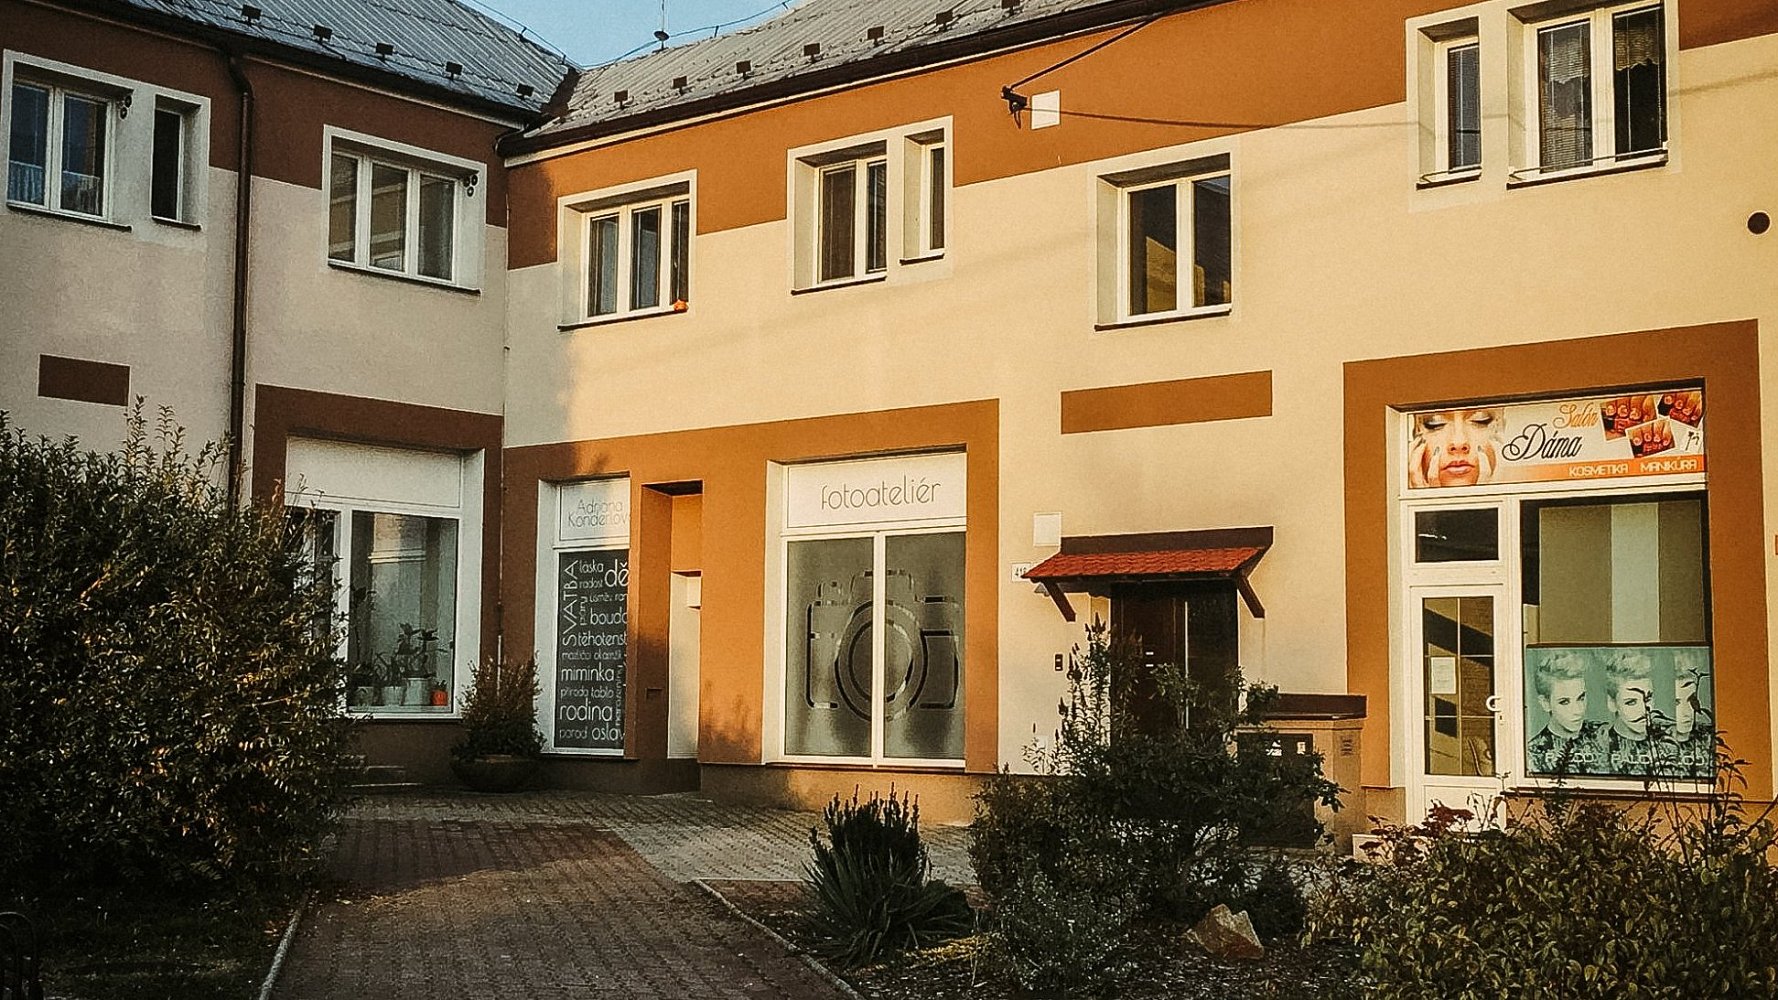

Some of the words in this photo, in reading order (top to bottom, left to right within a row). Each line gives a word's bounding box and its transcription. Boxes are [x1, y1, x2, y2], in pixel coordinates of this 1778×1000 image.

[1552, 402, 1599, 428] Salón
[1502, 423, 1583, 462] Dáma
[1569, 464, 1629, 477] KOSMETIKA
[1640, 456, 1697, 472] MANIKÚRA
[821, 474, 941, 510] fotoateliér
[567, 511, 629, 528] Konderlov
[604, 558, 629, 588] dě
[562, 560, 579, 647] SVATBA
[578, 630, 628, 647] těhotenst
[561, 662, 615, 682] miminka
[560, 697, 613, 722] rodina
[591, 721, 625, 741] oslav
